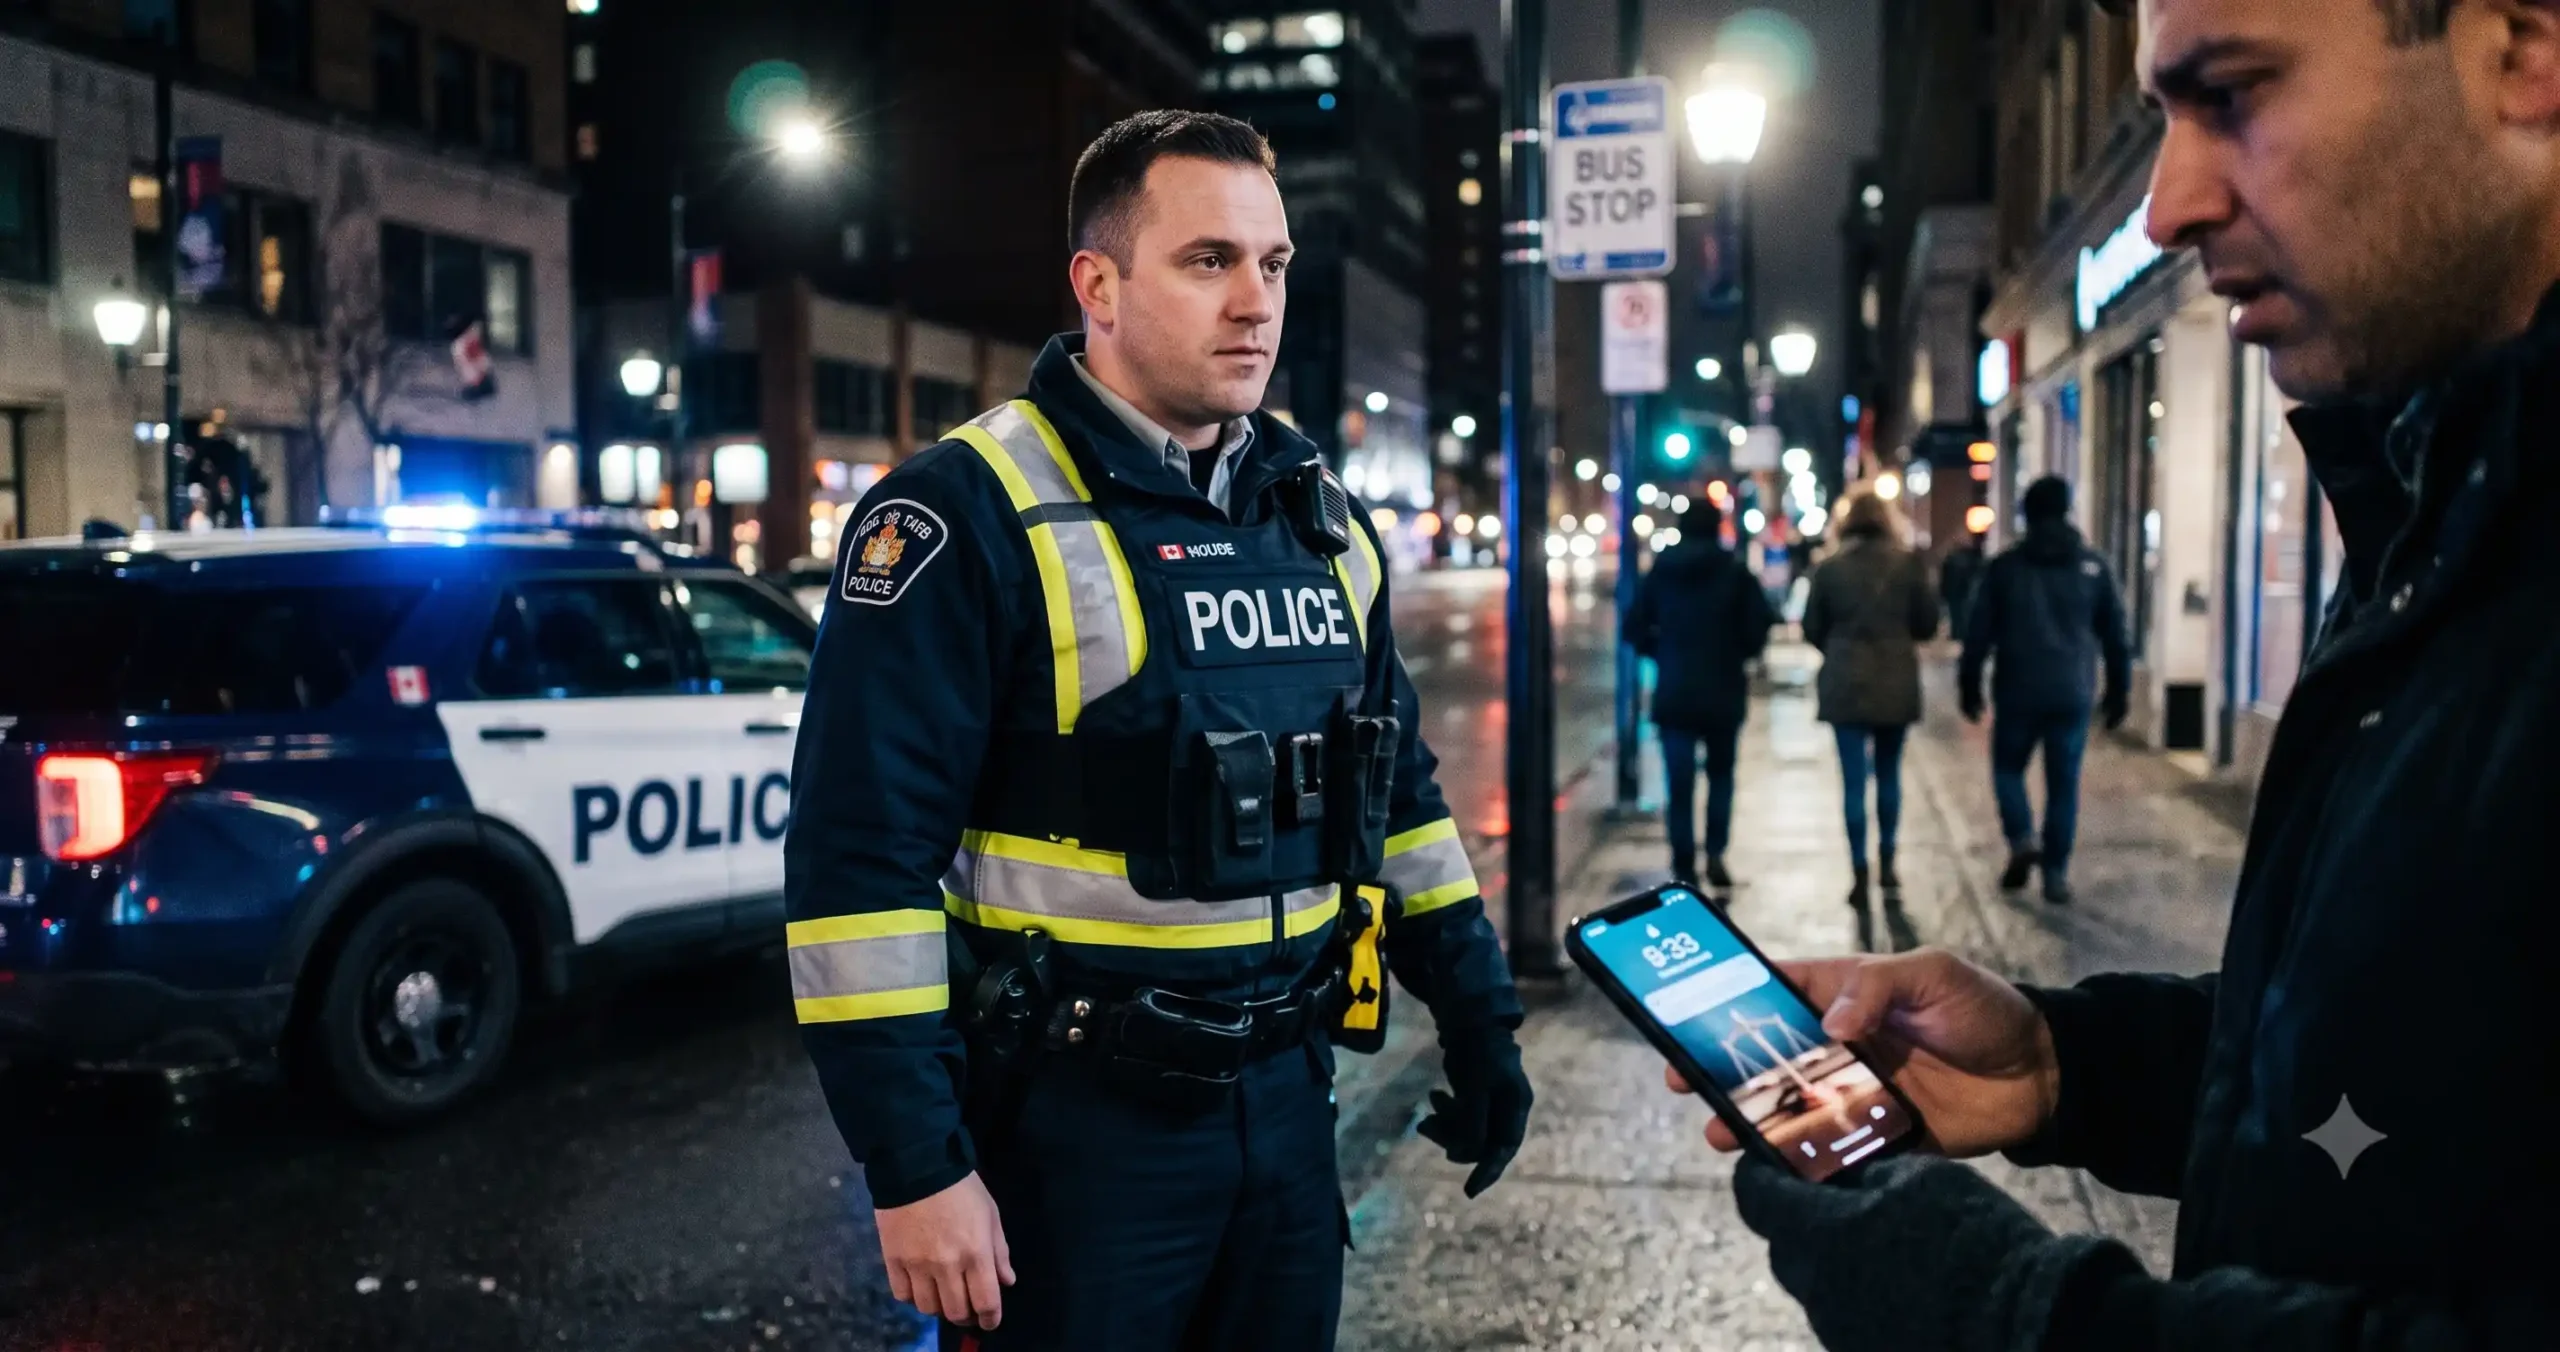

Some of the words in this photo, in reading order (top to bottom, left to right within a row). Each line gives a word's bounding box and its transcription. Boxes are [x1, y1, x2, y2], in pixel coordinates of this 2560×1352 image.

[1575, 146, 1645, 183] BUS
[1565, 188, 1657, 227] STOP
[848, 576, 894, 595] POLICE
[1184, 587, 1350, 651] POLICE
[573, 771, 790, 864] POLIC
